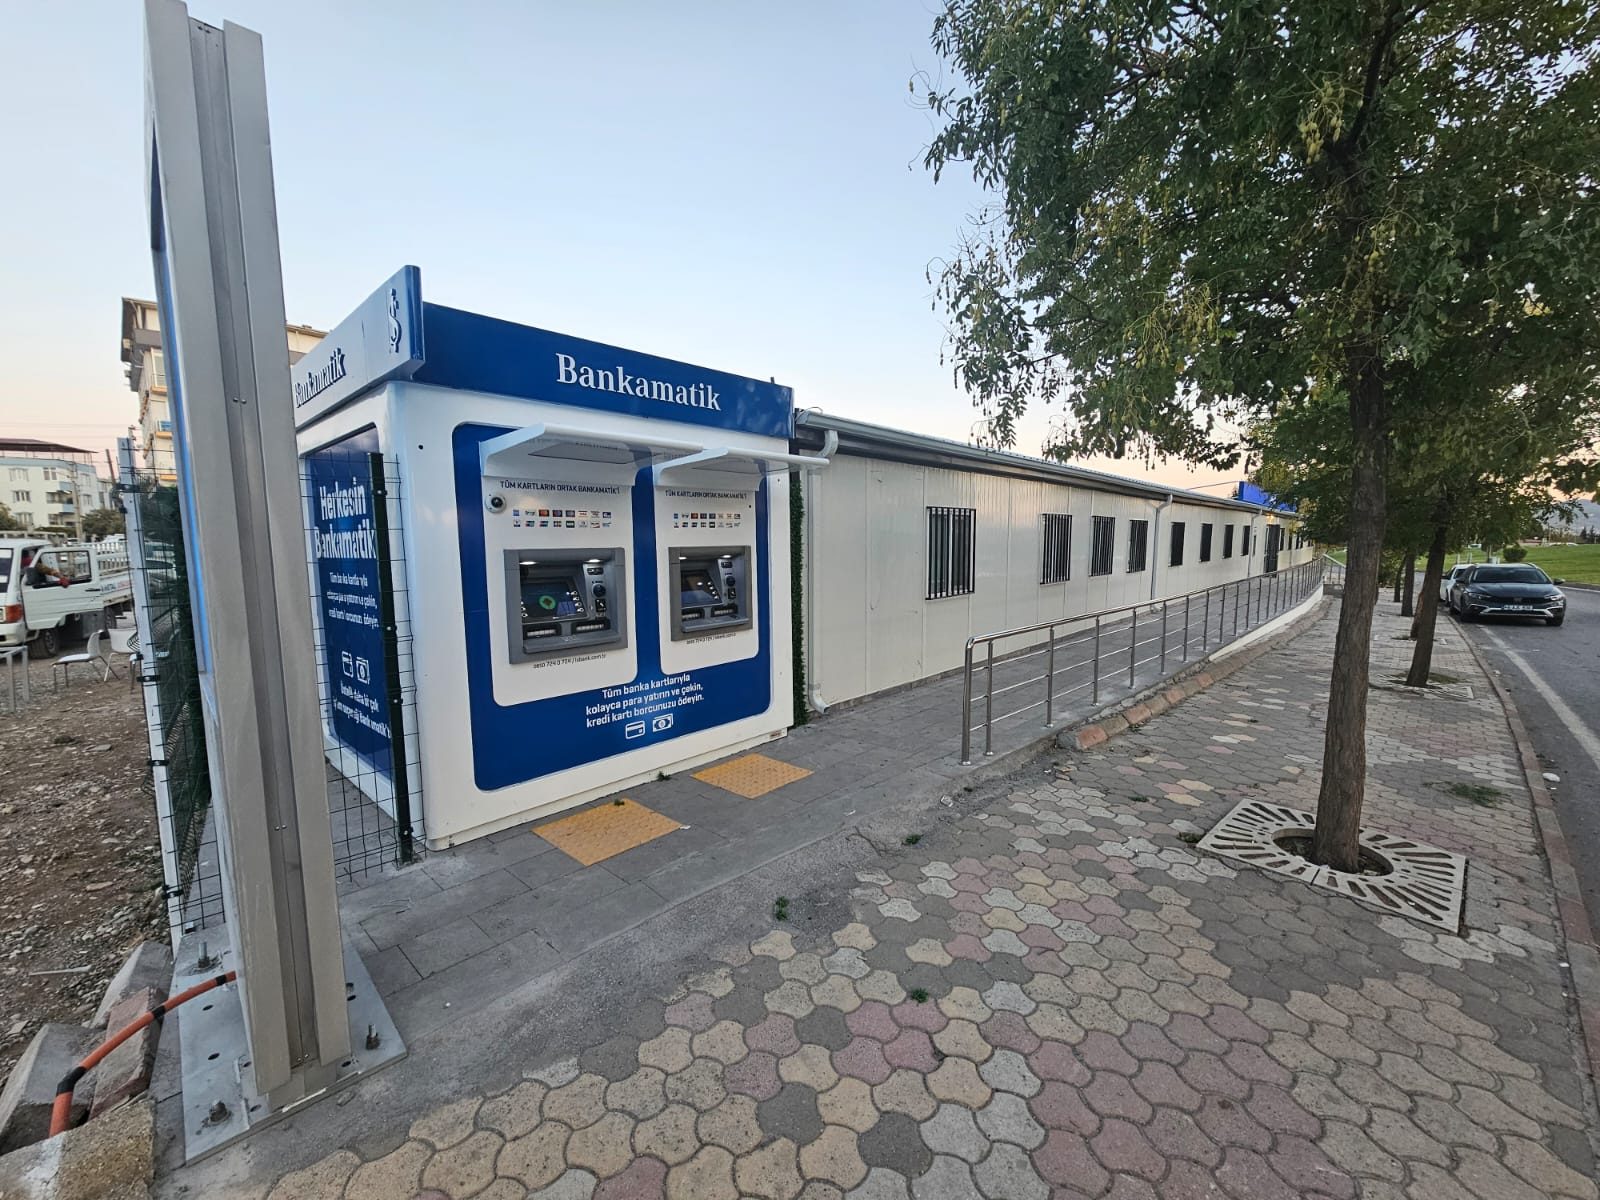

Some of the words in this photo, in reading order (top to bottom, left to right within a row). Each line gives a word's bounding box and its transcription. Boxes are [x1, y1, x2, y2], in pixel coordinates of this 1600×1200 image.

[295, 347, 346, 408] Bankamatik
[555, 352, 721, 411] Bankamatik
[319, 476, 366, 520] Herkesin
[500, 480, 516, 489] TÜM
[313, 518, 377, 559] Bankamatik
[585, 703, 621, 716] kolayca
[622, 697, 642, 710] para
[643, 690, 670, 704] yatırın
[671, 688, 681, 697] ve
[681, 682, 704, 694] çekin,
[602, 688, 622, 699] Tüm
[623, 681, 650, 696] banka
[650, 673, 691, 689] kartlarıyla
[586, 714, 612, 728] kredi
[611, 709, 633, 723] kartı
[633, 700, 677, 717] borcunuzu
[677, 692, 705, 707] ödeyin.
